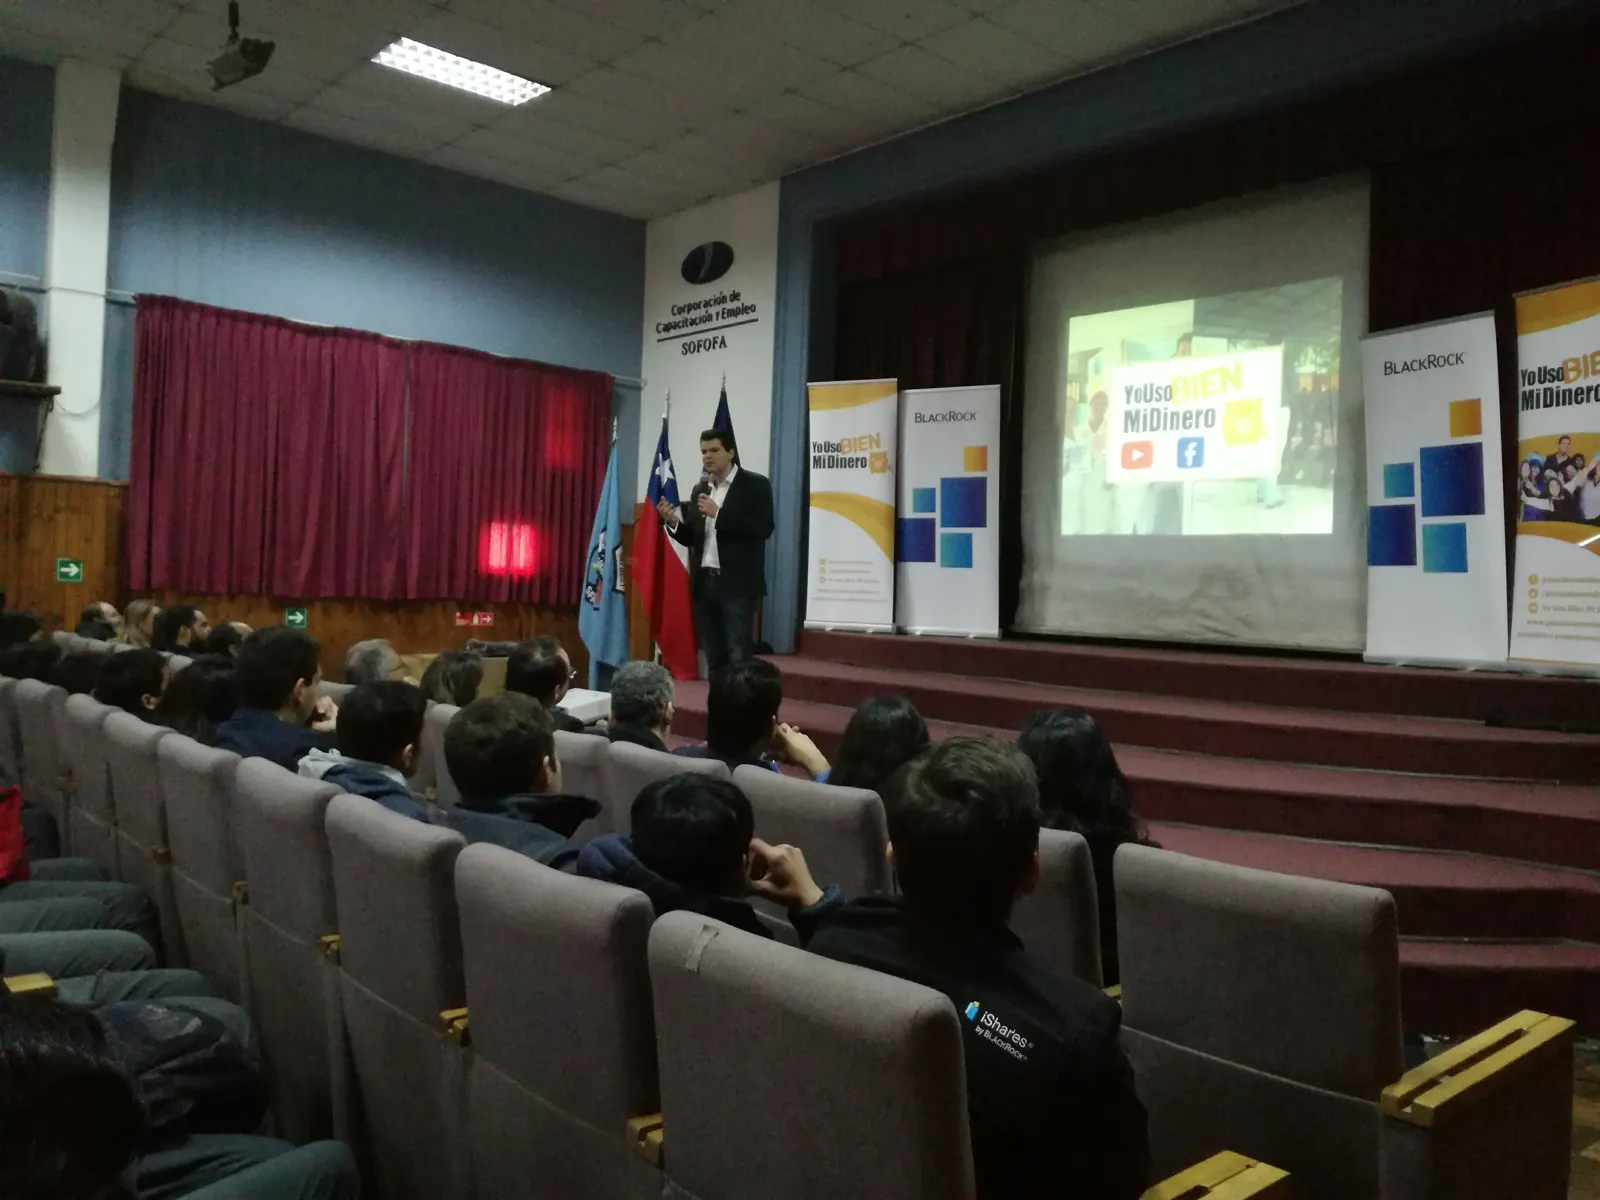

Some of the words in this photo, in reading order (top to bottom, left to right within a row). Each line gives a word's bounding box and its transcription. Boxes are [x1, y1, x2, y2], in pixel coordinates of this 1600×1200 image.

[671, 290, 728, 316] Corporación
[728, 289, 741, 303] de
[656, 310, 713, 334] Capacitación
[721, 303, 757, 320] Empleo
[682, 335, 728, 355] SOFOFA
[1562, 350, 1600, 384] BIE
[1171, 360, 1243, 406] BIEN
[1123, 407, 1217, 434] MiDinero
[840, 432, 881, 455] BIEN
[975, 1025, 985, 1035] by
